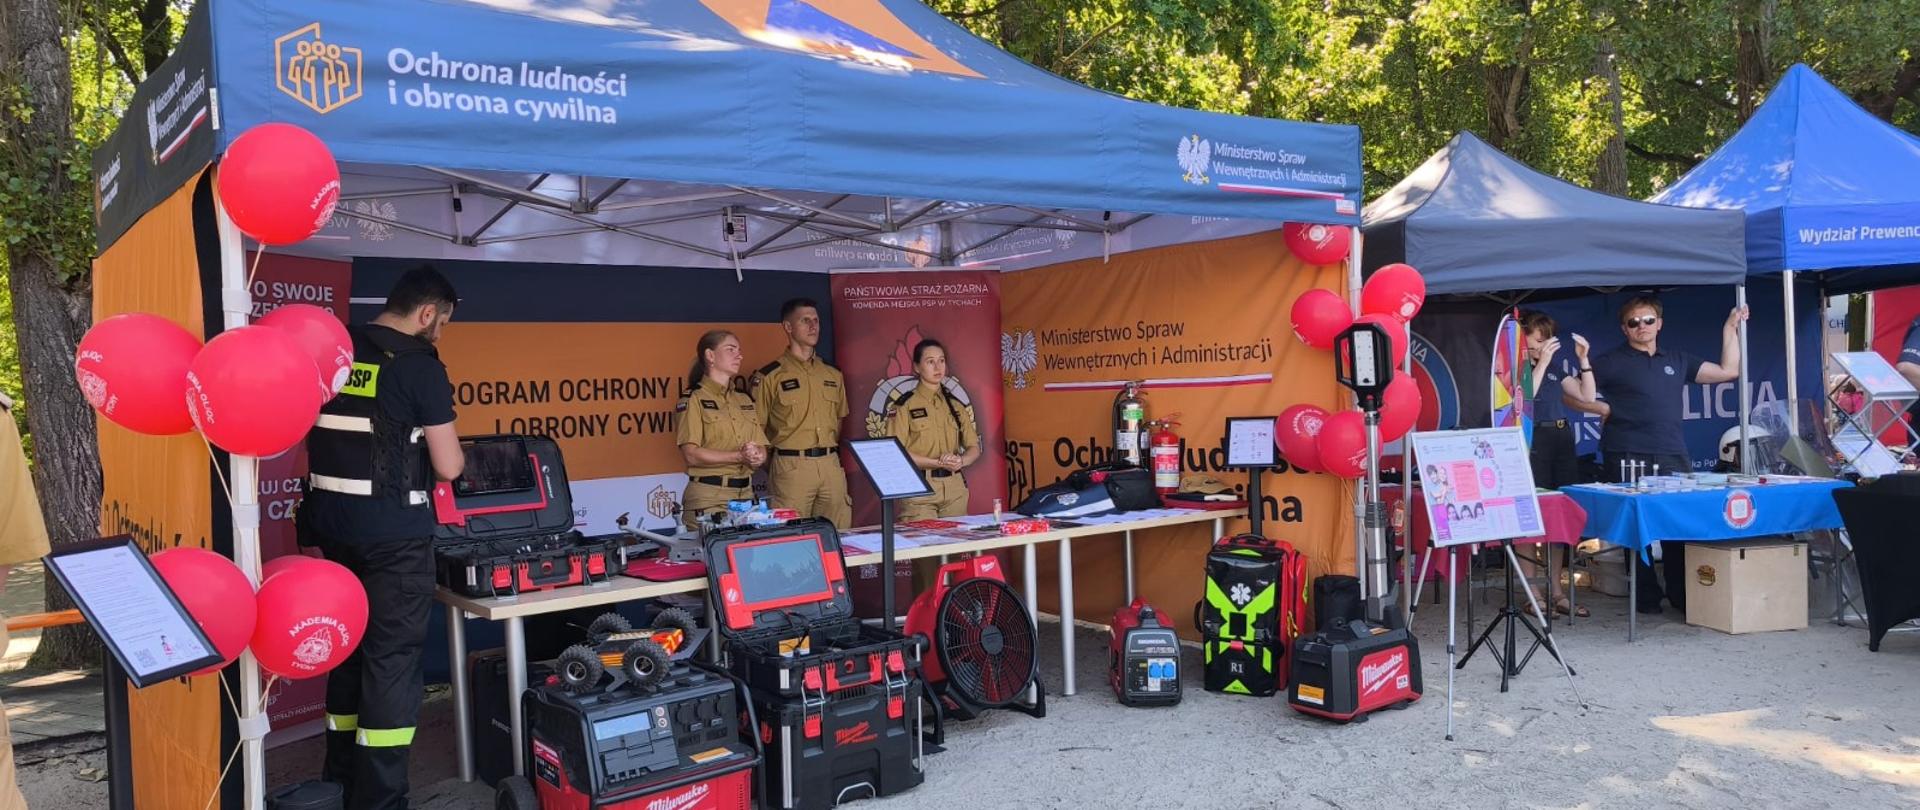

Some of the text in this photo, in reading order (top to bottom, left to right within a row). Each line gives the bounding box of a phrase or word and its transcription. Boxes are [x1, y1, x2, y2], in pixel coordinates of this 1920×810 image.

[387, 48, 627, 97] Ochrona ludności
[388, 79, 617, 124] i obrona cywilna
[1214, 142, 1306, 166] Ministerstwo Spraw
[1213, 161, 1347, 186] Wewnętrznych i Administracji
[1799, 227, 1857, 245] Wydział
[272, 282, 334, 302] SWOJE
[844, 283, 989, 297] PAŃSTWOWA STRAŻ POŻARNA
[852, 300, 889, 309] KOMENDA
[922, 299, 936, 307] PSP
[938, 299, 946, 307] W
[1041, 320, 1185, 347] Ministerstwo Spraw
[1043, 338, 1273, 372] Wewnętrznych i Administracji
[451, 380, 549, 406] ROGRAM
[559, 377, 671, 403] OCHRONY
[511, 413, 610, 438] OBRONY
[289, 615, 337, 638] AKADEMIA
[1230, 662, 1243, 674] R1
[1361, 652, 1403, 690] Milwaukee
[644, 782, 709, 810] Milwaukee
